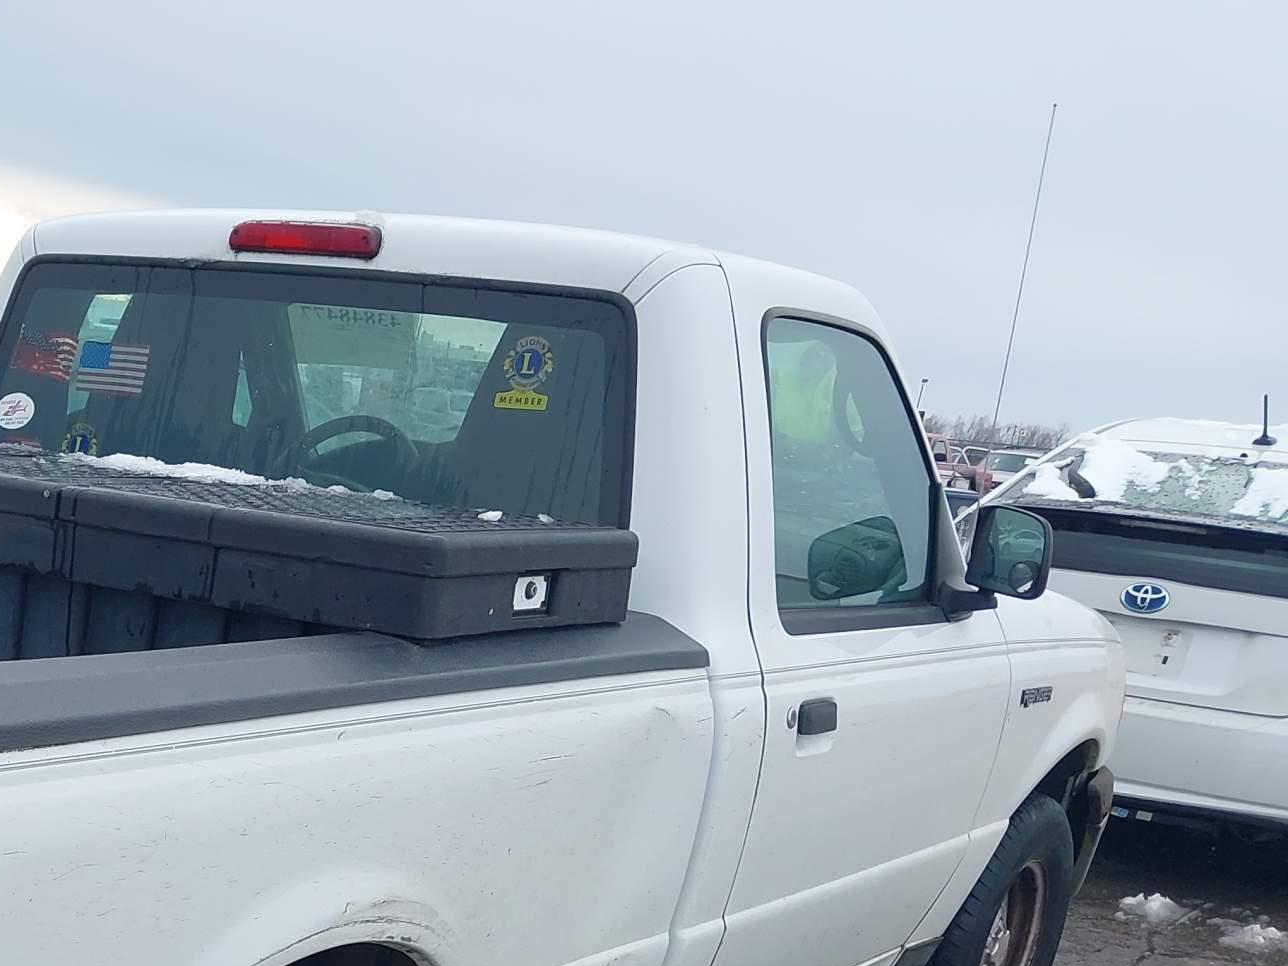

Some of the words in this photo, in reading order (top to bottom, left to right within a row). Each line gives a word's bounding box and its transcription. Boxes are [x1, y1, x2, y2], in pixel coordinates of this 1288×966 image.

[519, 338, 547, 351] LIONS
[520, 352, 535, 375] L
[498, 395, 543, 406] MEMBER
